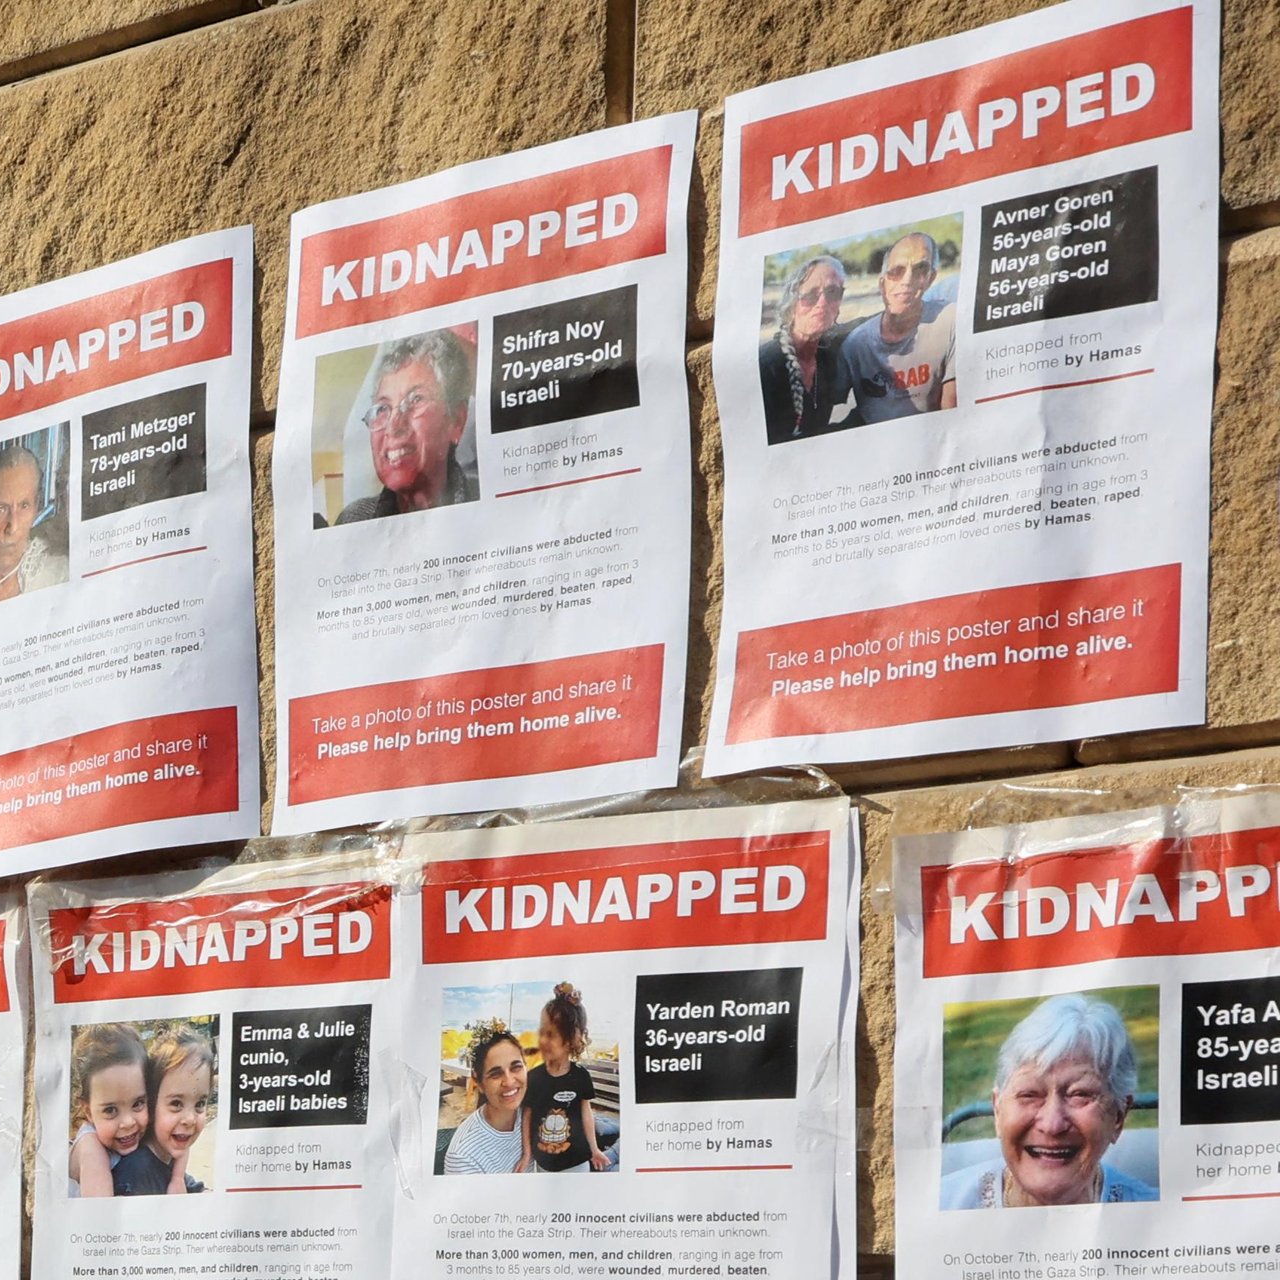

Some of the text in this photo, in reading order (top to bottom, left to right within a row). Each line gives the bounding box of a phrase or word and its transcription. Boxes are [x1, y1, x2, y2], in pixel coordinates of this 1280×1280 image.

[771, 63, 1155, 201] KIDNAPPED
[992, 190, 1113, 228] Avner Goren
[992, 211, 1111, 251] 56-years-old
[321, 193, 638, 306] KIDNAPPED
[991, 240, 1106, 274] Maya Goren
[502, 320, 604, 354] Shifra Noy
[502, 339, 622, 381] 70-years-old
[90, 412, 196, 450] Tami Metzger
[90, 434, 187, 474] 78-years-old
[771, 635, 1132, 701] Please help bring them home alive.
[445, 865, 805, 933] KIDNAPPED
[948, 862, 1280, 944] KIDNAPP
[71, 910, 372, 975] KIDNAPPED
[646, 1000, 790, 1020] Yarden Roman
[1197, 1003, 1255, 1026] Yafa
[241, 1021, 355, 1042] Emma Julie
[645, 1024, 765, 1049] 36-years-old
[240, 1048, 289, 1066] cunio,
[646, 1053, 702, 1072] Israeli
[239, 1070, 331, 1092] 3-years-old
[239, 1094, 347, 1113] Israeli babies
[707, 1137, 772, 1152] by Hamas
